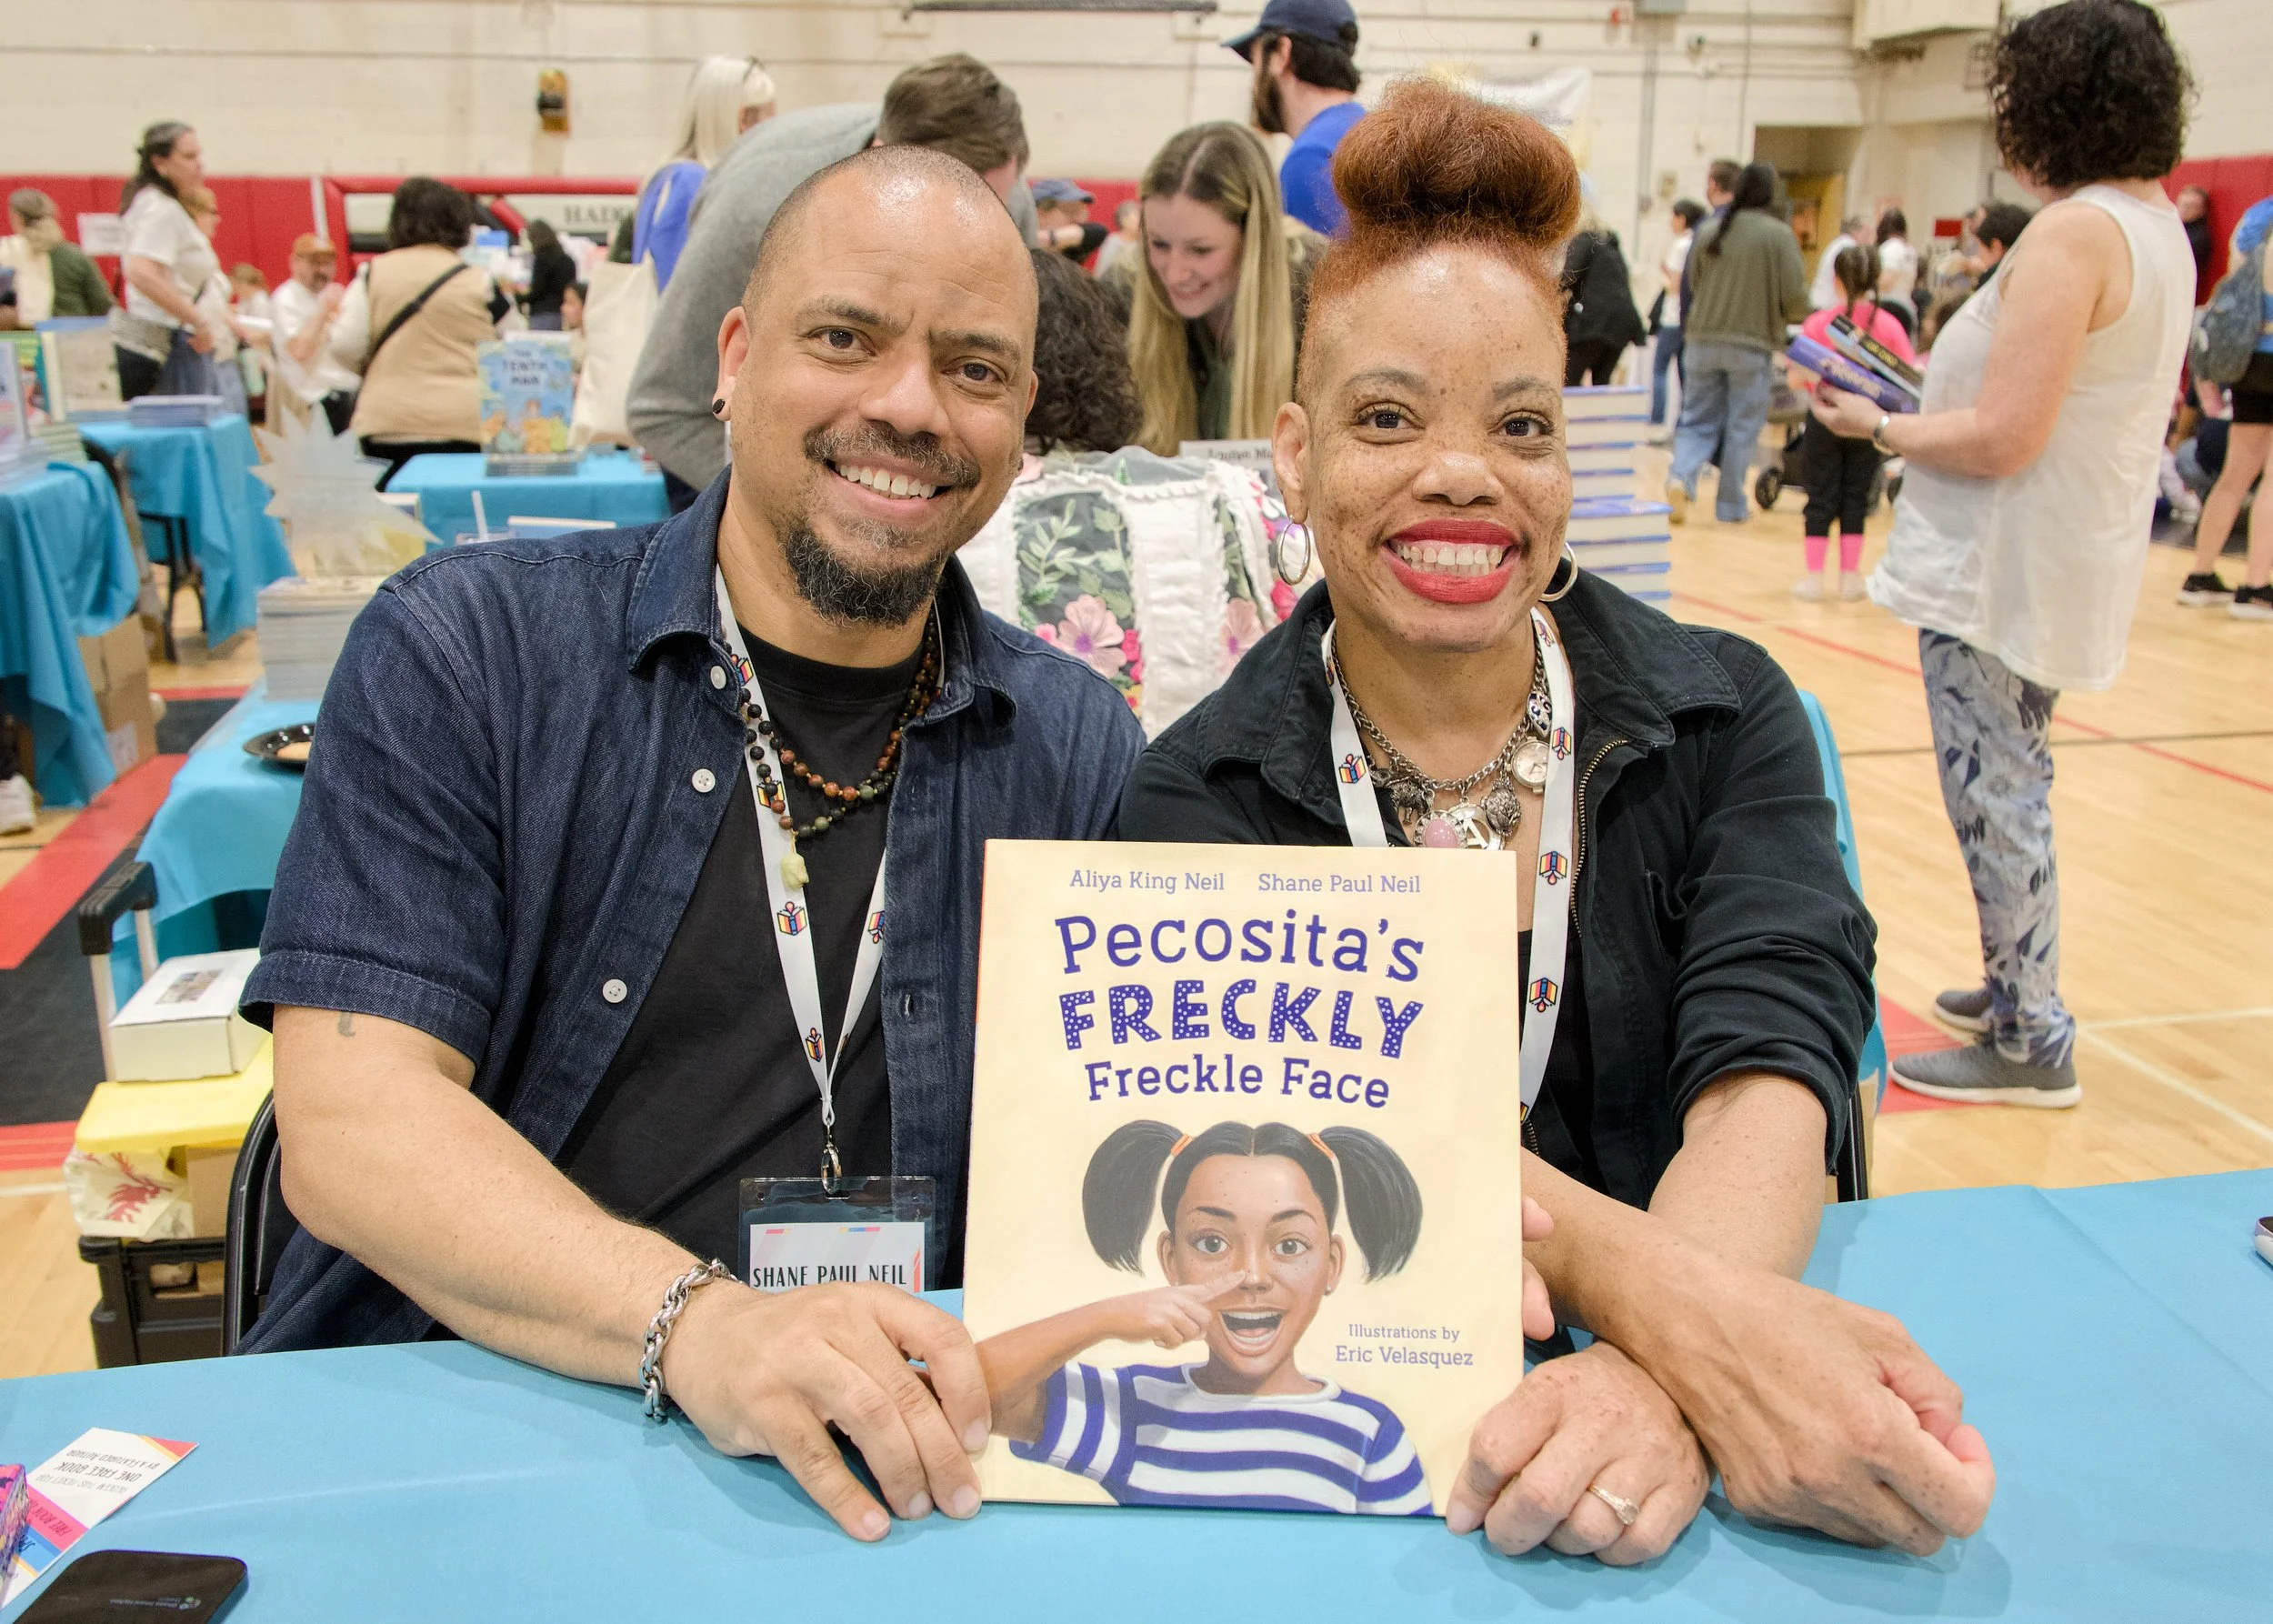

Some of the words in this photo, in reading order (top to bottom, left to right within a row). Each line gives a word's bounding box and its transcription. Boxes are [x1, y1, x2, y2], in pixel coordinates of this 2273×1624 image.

[1069, 870, 1123, 893] Aliya
[1129, 871, 1177, 895] King
[1185, 872, 1226, 891] Neil
[1257, 873, 1323, 892] Shane
[1330, 874, 1373, 893] Paul
[1381, 876, 1421, 894] Neil
[1055, 909, 1425, 982] Pecosita's
[1059, 978, 1425, 1059] FRECKLY
[1085, 1054, 1264, 1102] Freckle
[1280, 1057, 1390, 1108] Face
[753, 1265, 809, 1288] SHANE
[869, 1264, 906, 1285] NEIL
[1348, 1324, 1437, 1339] Illustrations
[1442, 1327, 1460, 1343] by
[1336, 1345, 1373, 1363] Eric
[1378, 1347, 1474, 1369] Velasquez
[55, 1461, 89, 1475] BOOK
[86, 1465, 118, 1479] FREE
[115, 1469, 142, 1482] ONE
